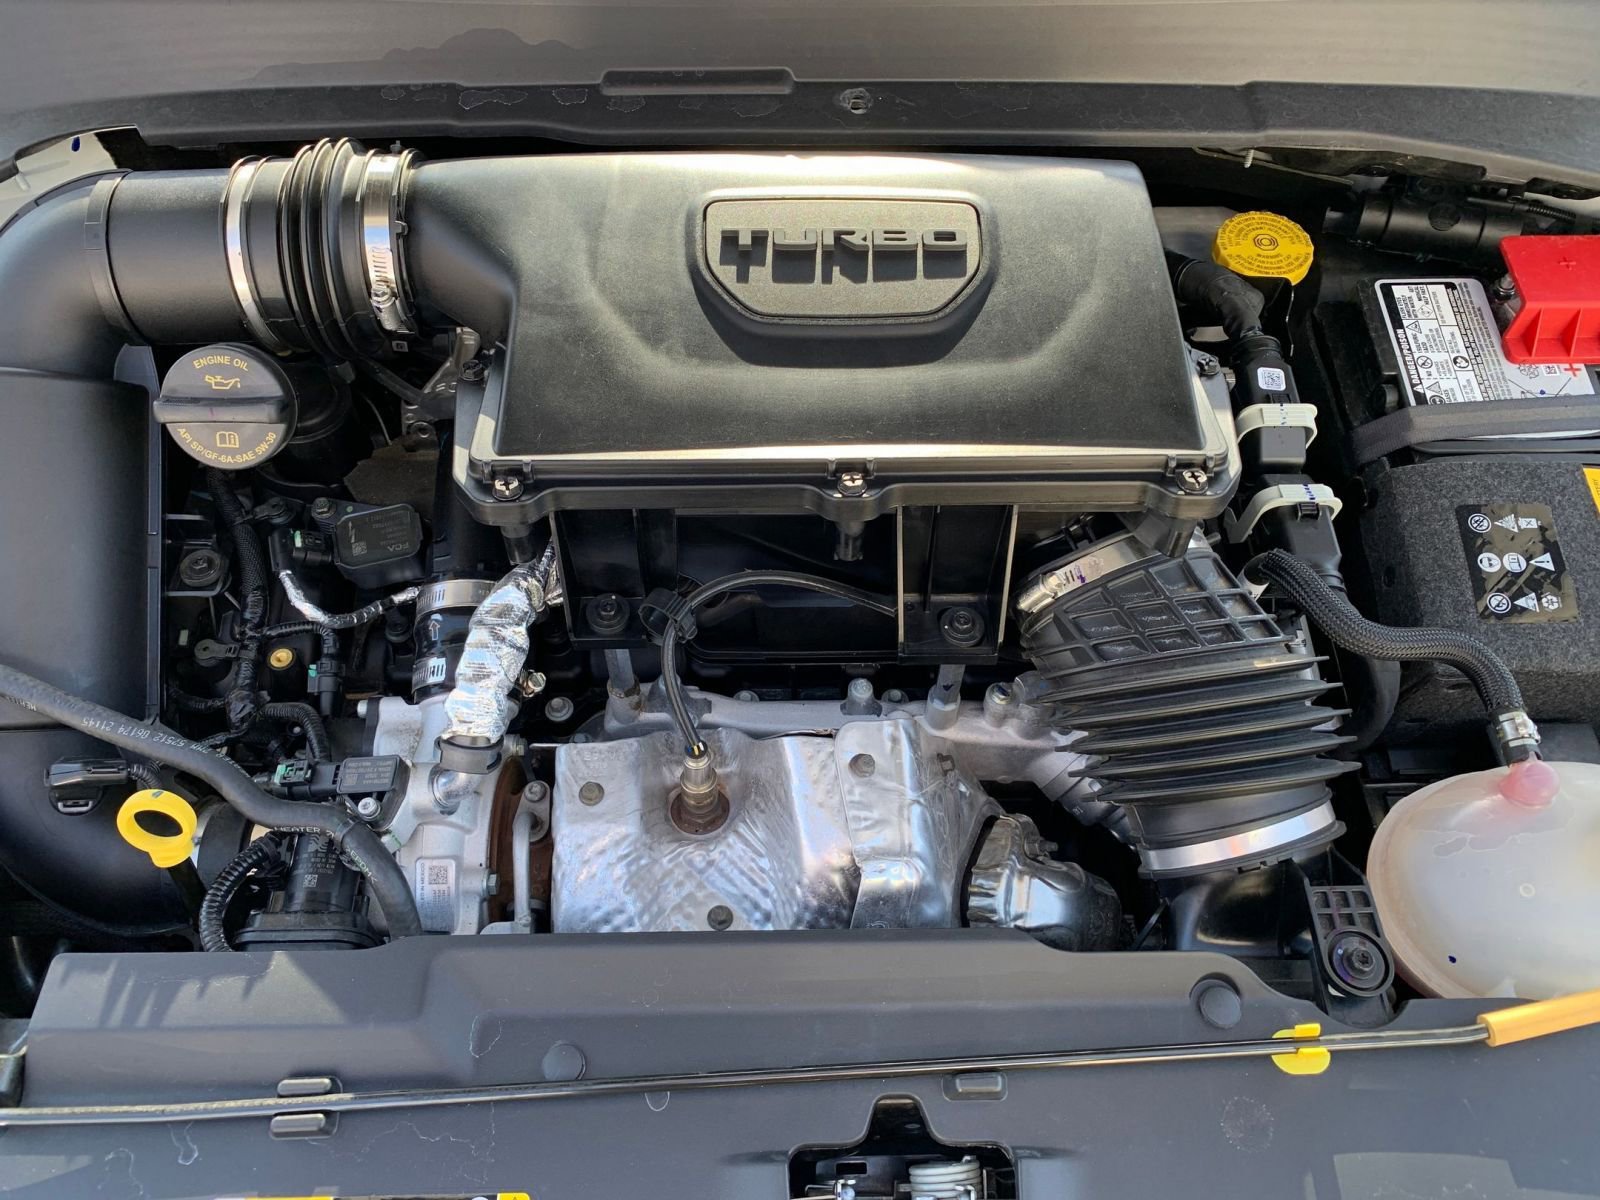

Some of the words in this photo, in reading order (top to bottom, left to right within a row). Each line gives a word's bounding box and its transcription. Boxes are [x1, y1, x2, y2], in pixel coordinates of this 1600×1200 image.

[193, 355, 231, 369] ENGINE
[233, 358, 249, 371] OIL
[1396, 328, 1420, 383] DANGER/POISON
[177, 428, 193, 442] API
[190, 441, 256, 464] SP/GF-6A-SAE
[255, 432, 276, 455] 5W-30
[387, 542, 409, 552] FCA
